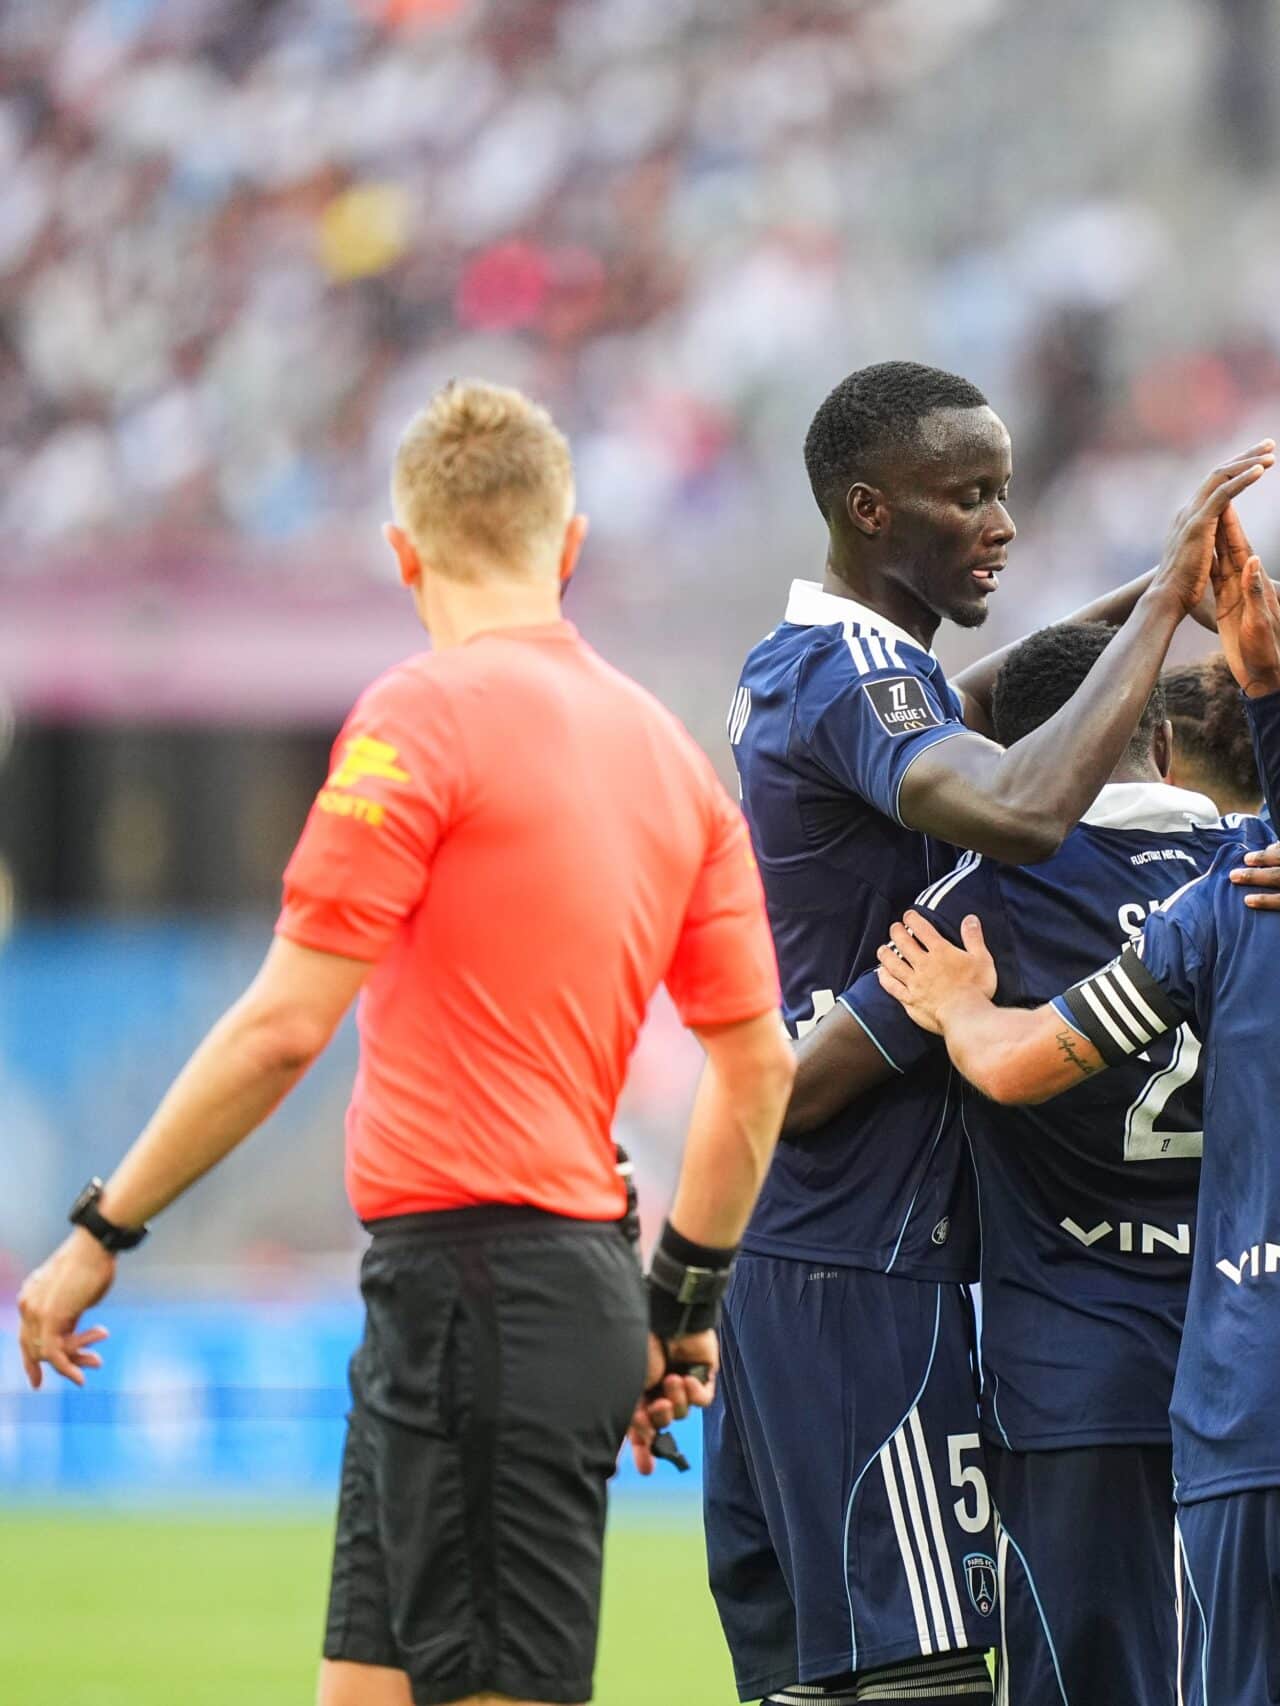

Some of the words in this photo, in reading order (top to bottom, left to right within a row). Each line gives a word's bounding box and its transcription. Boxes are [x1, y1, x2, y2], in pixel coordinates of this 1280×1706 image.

[884, 709, 919, 723] LIGUE
[1059, 1216, 1191, 1255] VIN
[946, 1432, 991, 1534] 5
